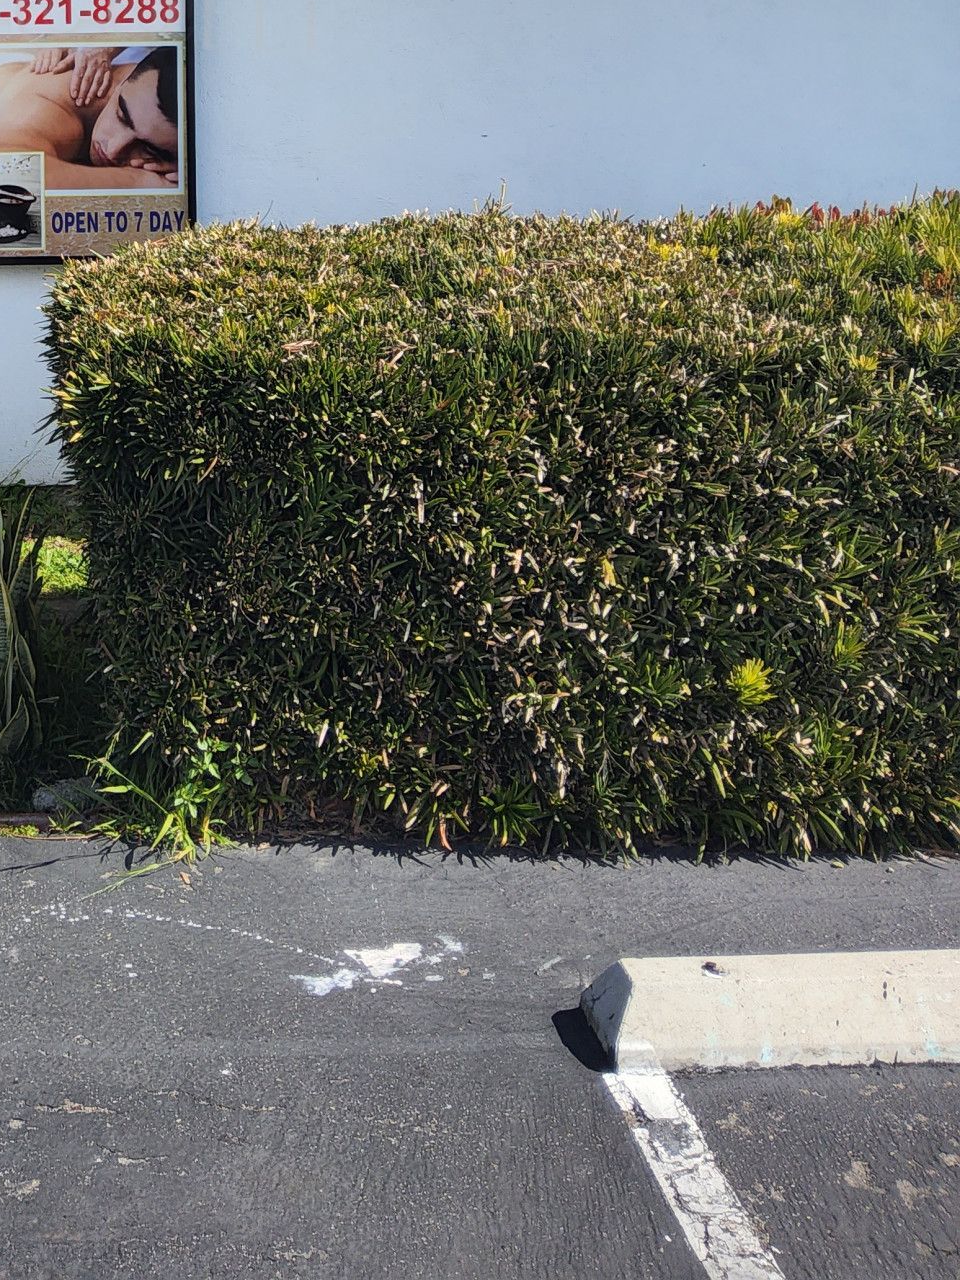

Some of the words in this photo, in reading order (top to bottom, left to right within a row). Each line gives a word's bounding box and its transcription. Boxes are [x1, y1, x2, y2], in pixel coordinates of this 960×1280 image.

[51, 211, 98, 234] OPEN
[104, 211, 128, 232] TO
[134, 211, 144, 232] 7
[149, 210, 185, 232] DAY
